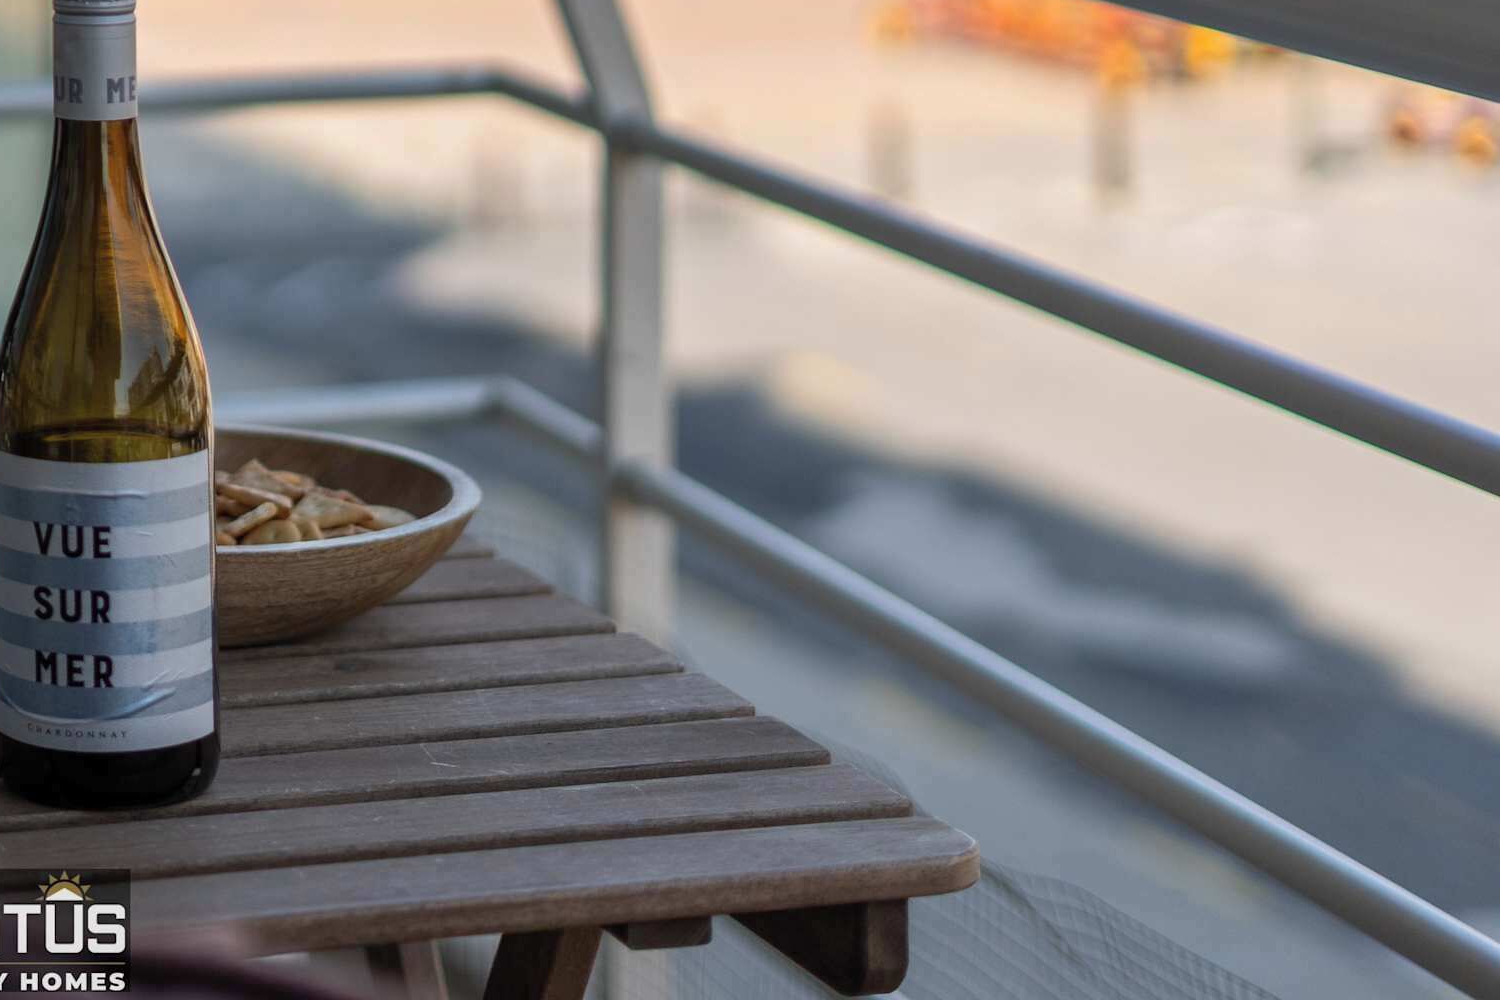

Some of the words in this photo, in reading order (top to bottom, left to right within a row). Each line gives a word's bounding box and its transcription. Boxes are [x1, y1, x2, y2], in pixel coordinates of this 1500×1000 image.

[33, 521, 112, 560] VUE
[33, 586, 112, 624] SUR
[34, 649, 115, 689] MER
[27, 722, 129, 740] CHARDONNAY
